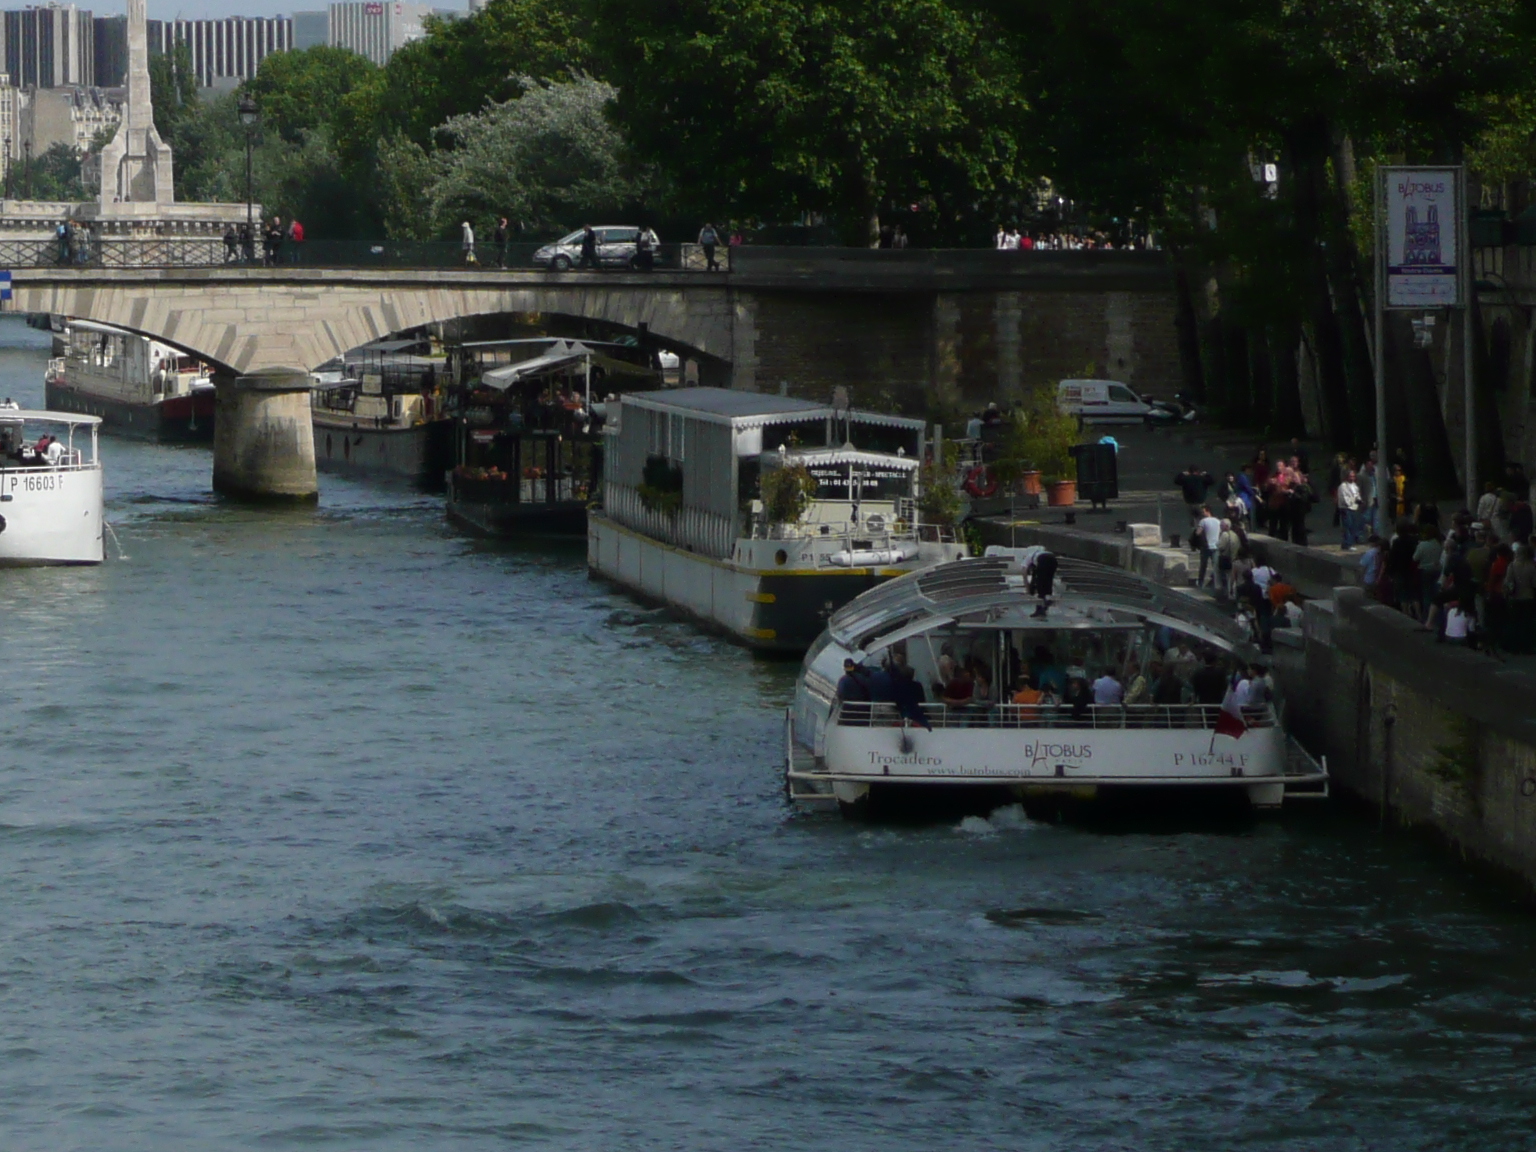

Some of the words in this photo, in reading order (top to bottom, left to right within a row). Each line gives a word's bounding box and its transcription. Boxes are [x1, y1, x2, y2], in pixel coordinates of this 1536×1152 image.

[1398, 176, 1445, 199] BATOBUS
[10, 476, 18, 492] P
[23, 475, 55, 492] 16603
[868, 751, 943, 767] Trocadero
[1024, 739, 1093, 771] BATOBUS
[1174, 752, 1183, 766] P
[1240, 753, 1249, 766] F
[926, 764, 1032, 776] www.batobus.com
